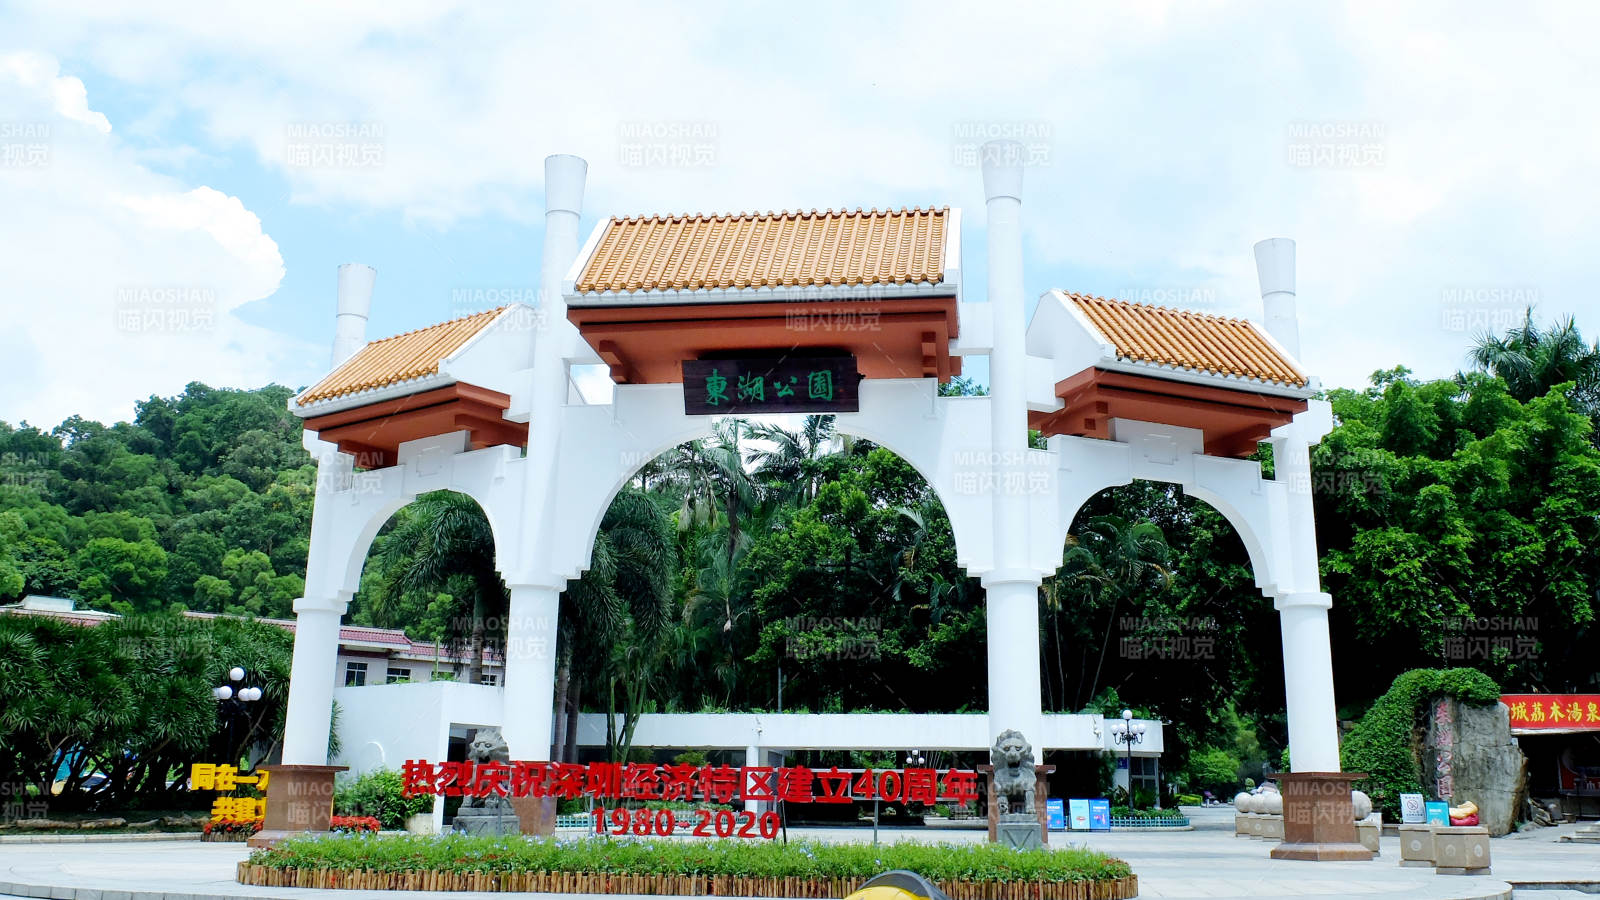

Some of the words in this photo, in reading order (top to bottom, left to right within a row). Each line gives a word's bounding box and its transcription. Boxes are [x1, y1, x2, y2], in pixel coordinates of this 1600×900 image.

[401, 759, 979, 807] 热烈庆祝深圳经济特区建立40周年
[591, 807, 781, 839] 1980-2020
